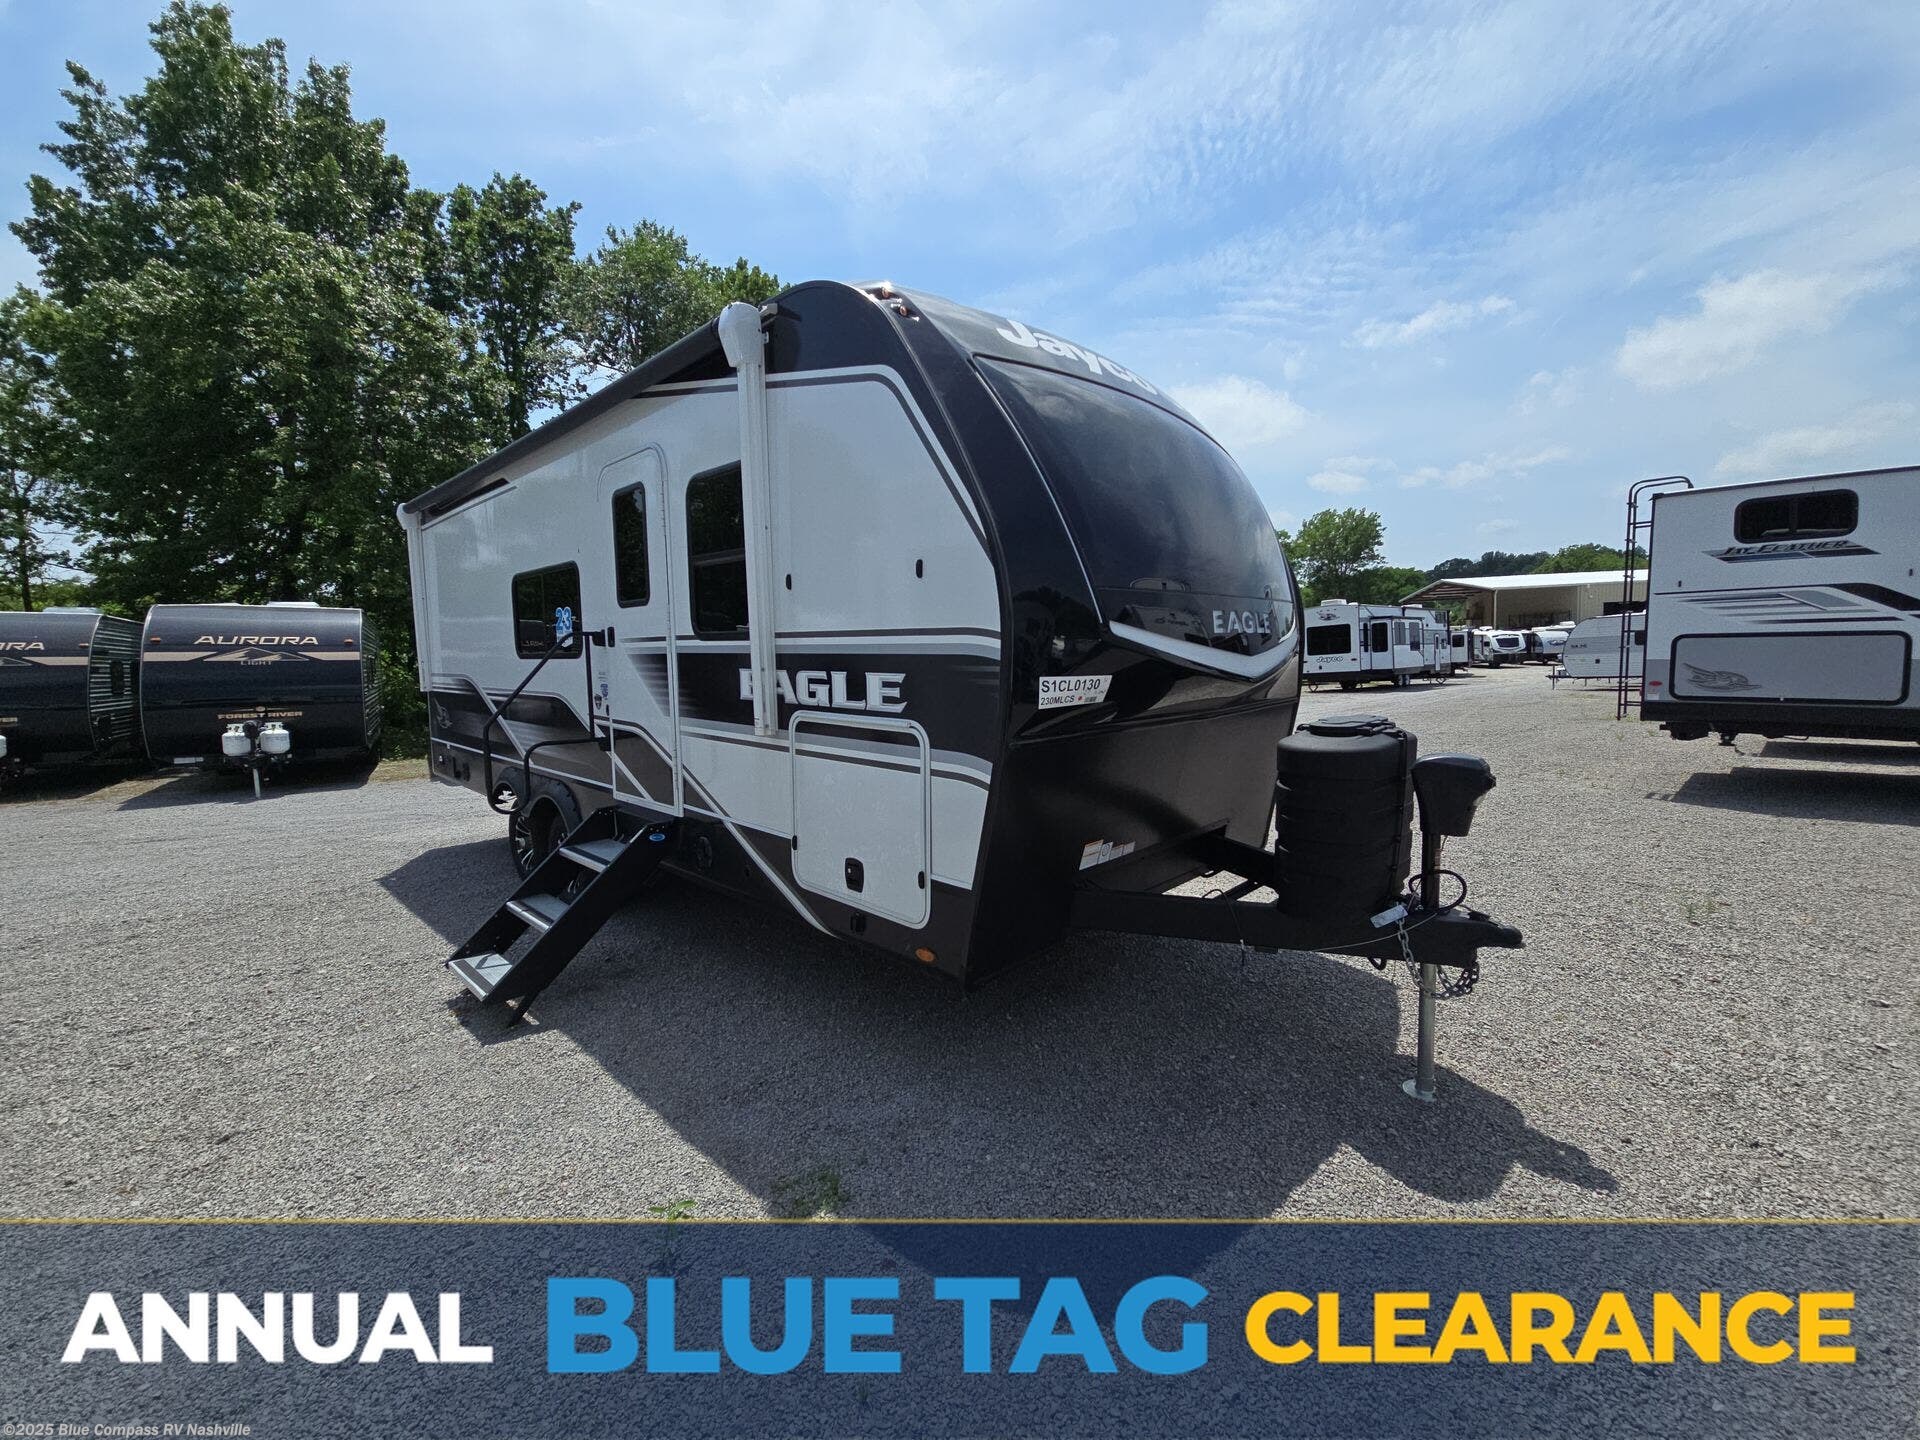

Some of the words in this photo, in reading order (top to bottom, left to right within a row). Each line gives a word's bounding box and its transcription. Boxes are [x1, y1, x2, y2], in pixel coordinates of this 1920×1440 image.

[996, 319, 1158, 396] Jayco
[1212, 610, 1271, 634] EAGLE
[193, 635, 319, 645] AURORA
[1041, 679, 1101, 693] S1CL0130
[1040, 695, 1075, 706] 230MLCS
